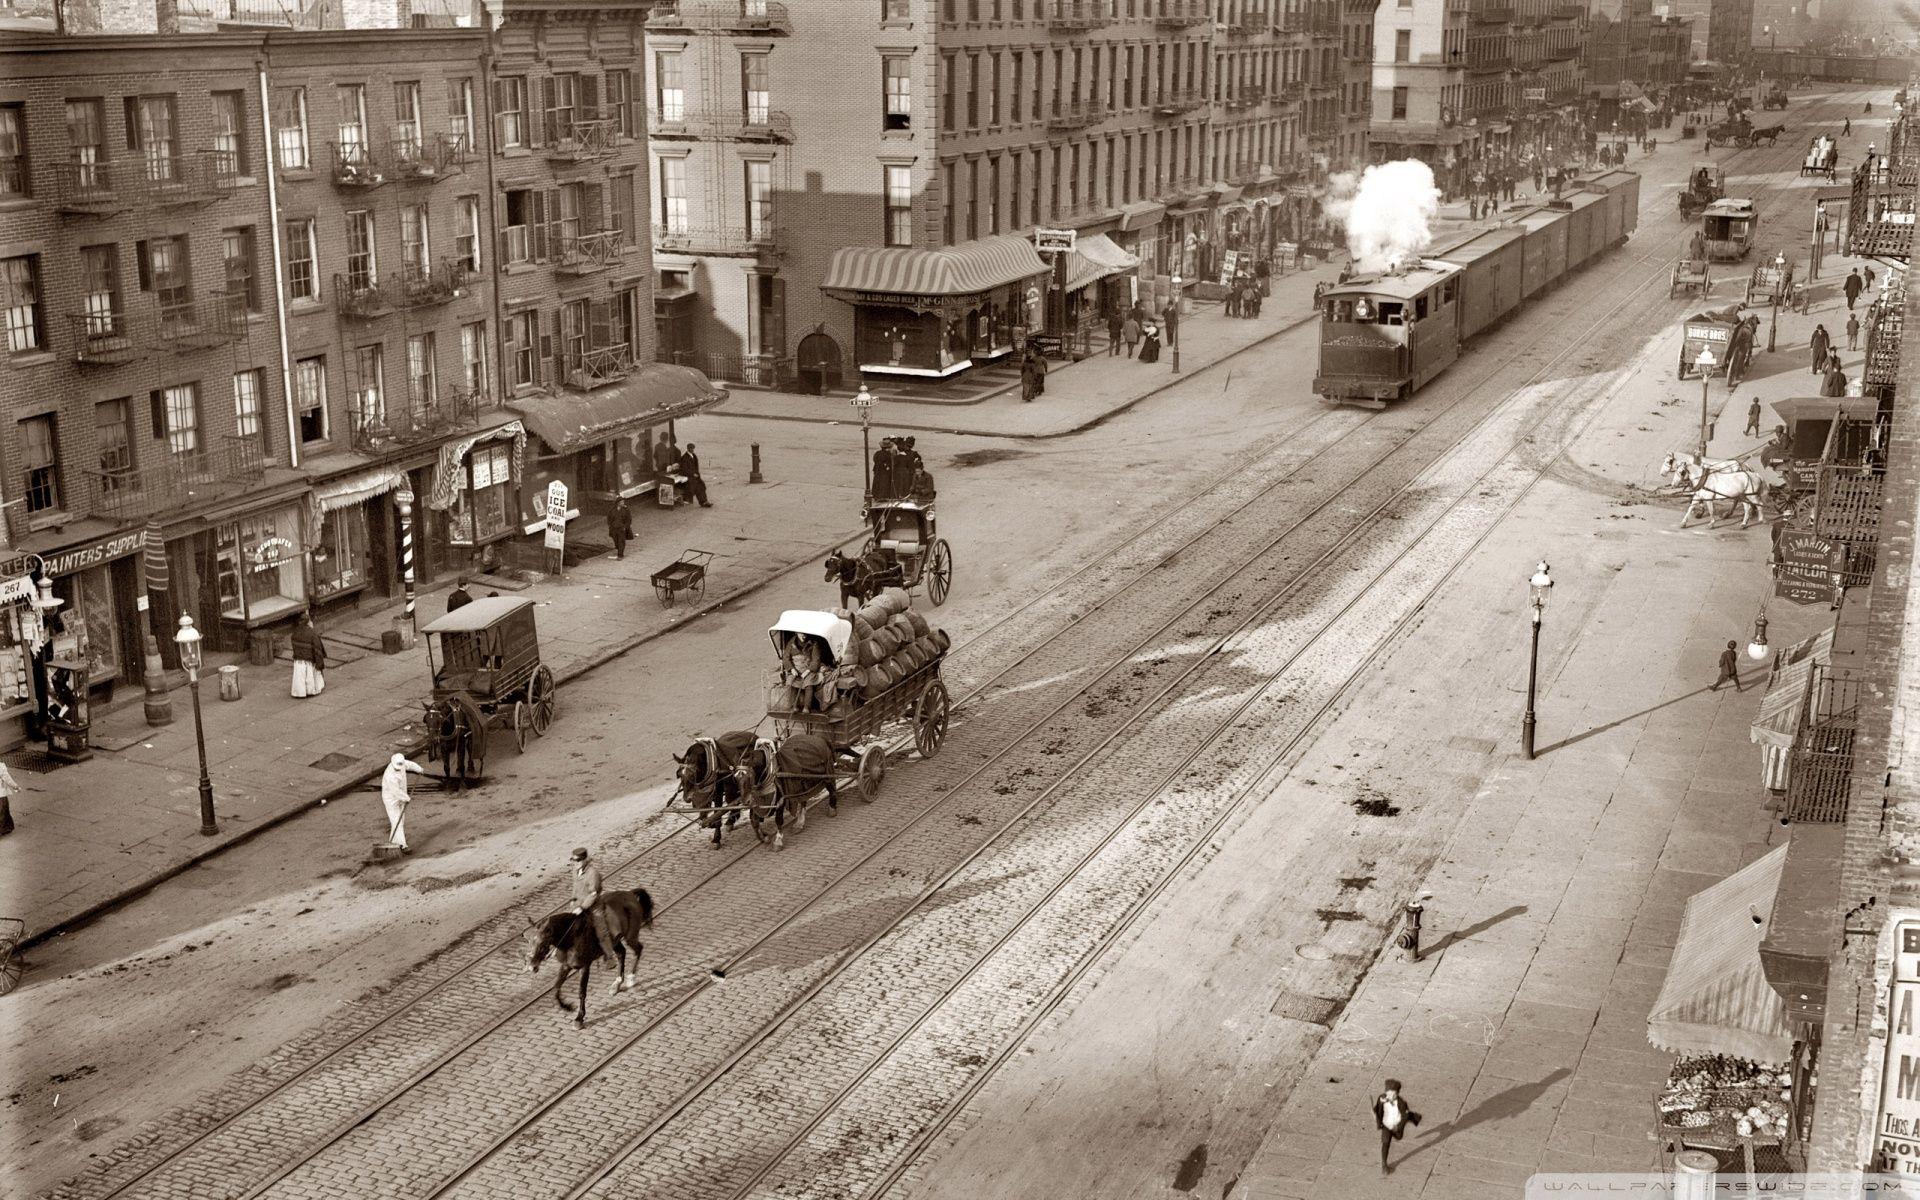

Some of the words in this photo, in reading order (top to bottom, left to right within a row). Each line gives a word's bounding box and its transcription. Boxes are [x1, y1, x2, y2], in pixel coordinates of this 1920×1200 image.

[549, 496, 565, 507] ICE
[547, 506, 565, 517] COAL
[547, 521, 565, 534] WOOD
[43, 545, 103, 575] PAINTERS
[106, 530, 148, 558] SUPPLIE
[1786, 561, 1828, 579] TAILOR
[4, 582, 20, 595] 267
[656, 579, 671, 589] ICE
[1790, 588, 1816, 600] 272
